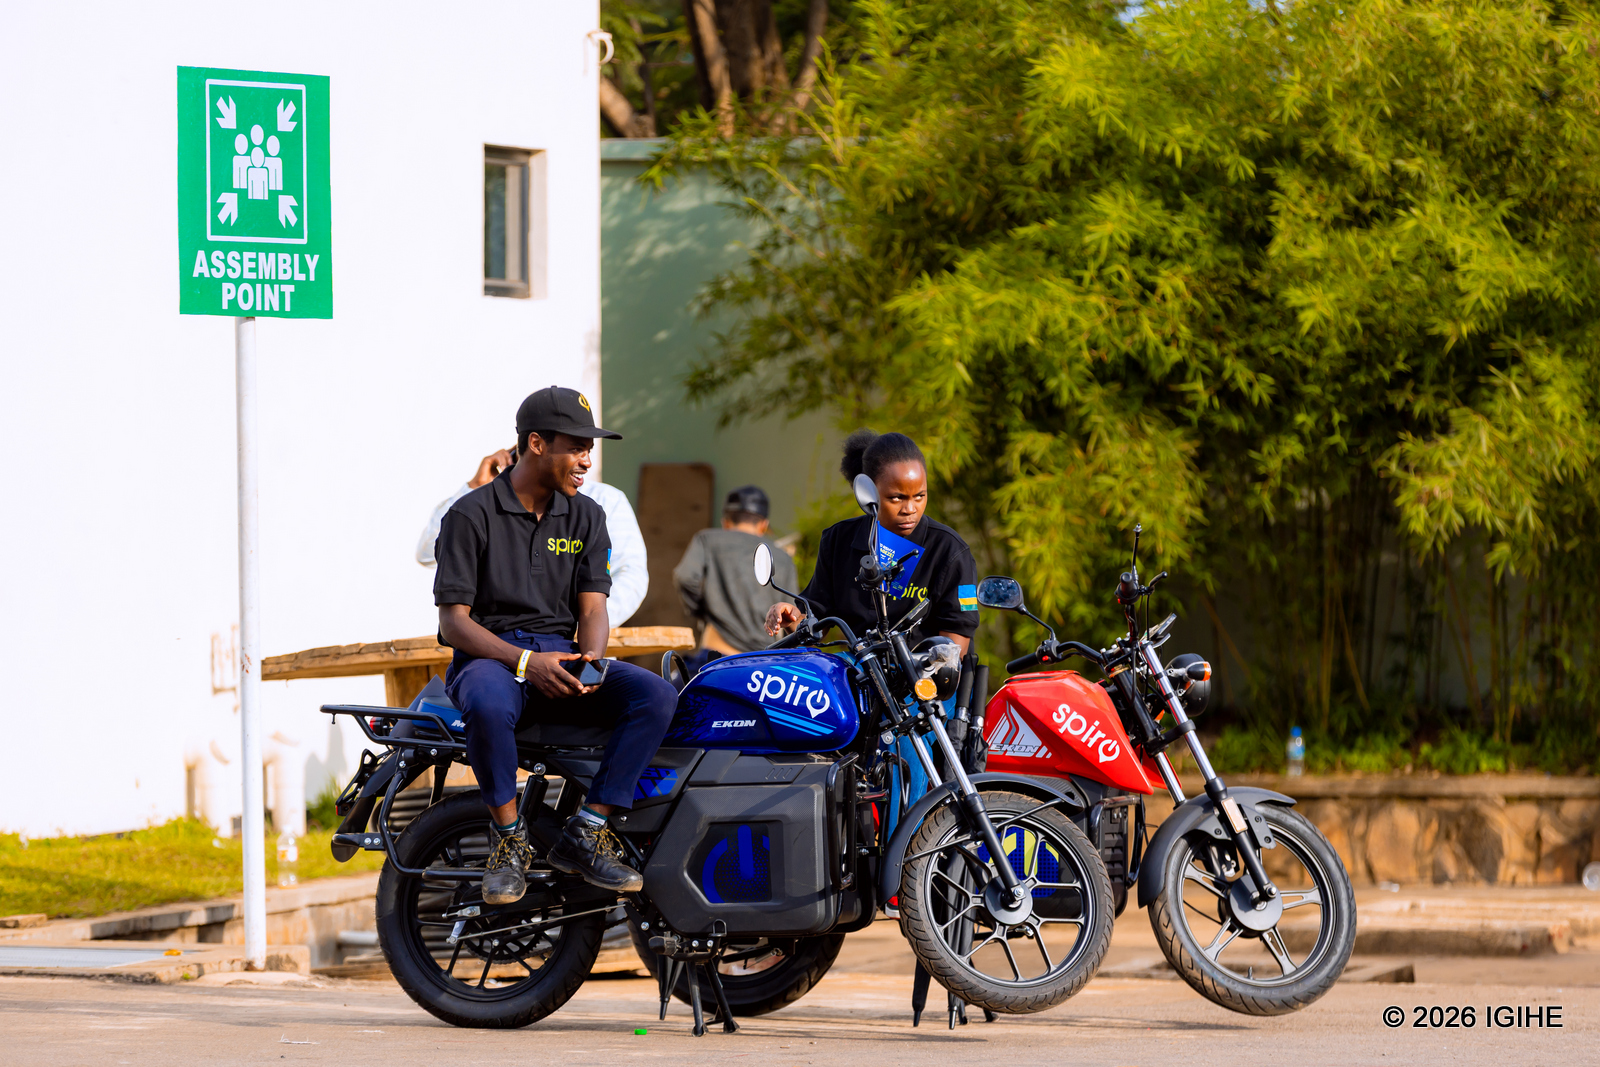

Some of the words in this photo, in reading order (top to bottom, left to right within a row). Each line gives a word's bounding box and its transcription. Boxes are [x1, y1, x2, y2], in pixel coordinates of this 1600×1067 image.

[192, 250, 320, 281] ASSEMBLY
[222, 282, 295, 312] POINT
[747, 670, 830, 719] spiro
[711, 719, 757, 728] EKON
[1052, 703, 1120, 763] spiro
